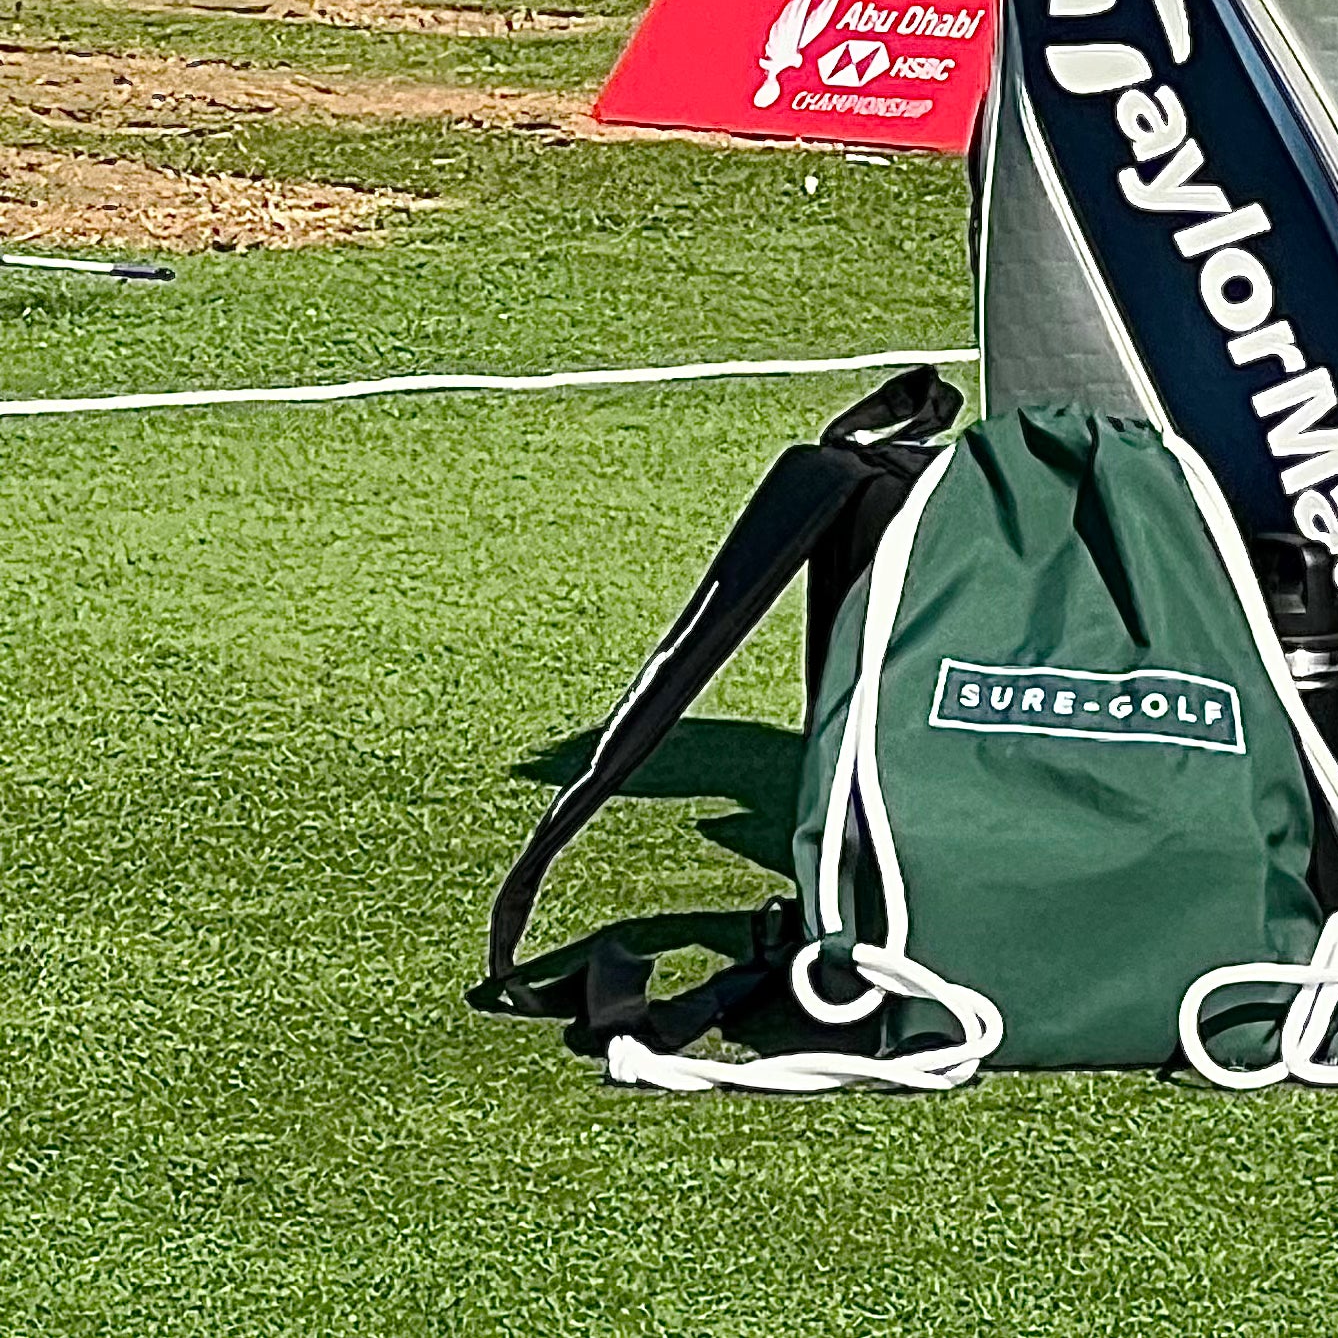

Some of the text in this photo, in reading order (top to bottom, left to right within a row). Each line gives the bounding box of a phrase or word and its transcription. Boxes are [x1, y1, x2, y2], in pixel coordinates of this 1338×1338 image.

[836, 1, 985, 39] Abu Dhabi
[889, 56, 956, 81] HSBC
[791, 91, 933, 118] CHAMPIONSHIP
[959, 683, 1222, 725] SURE-GOLF
